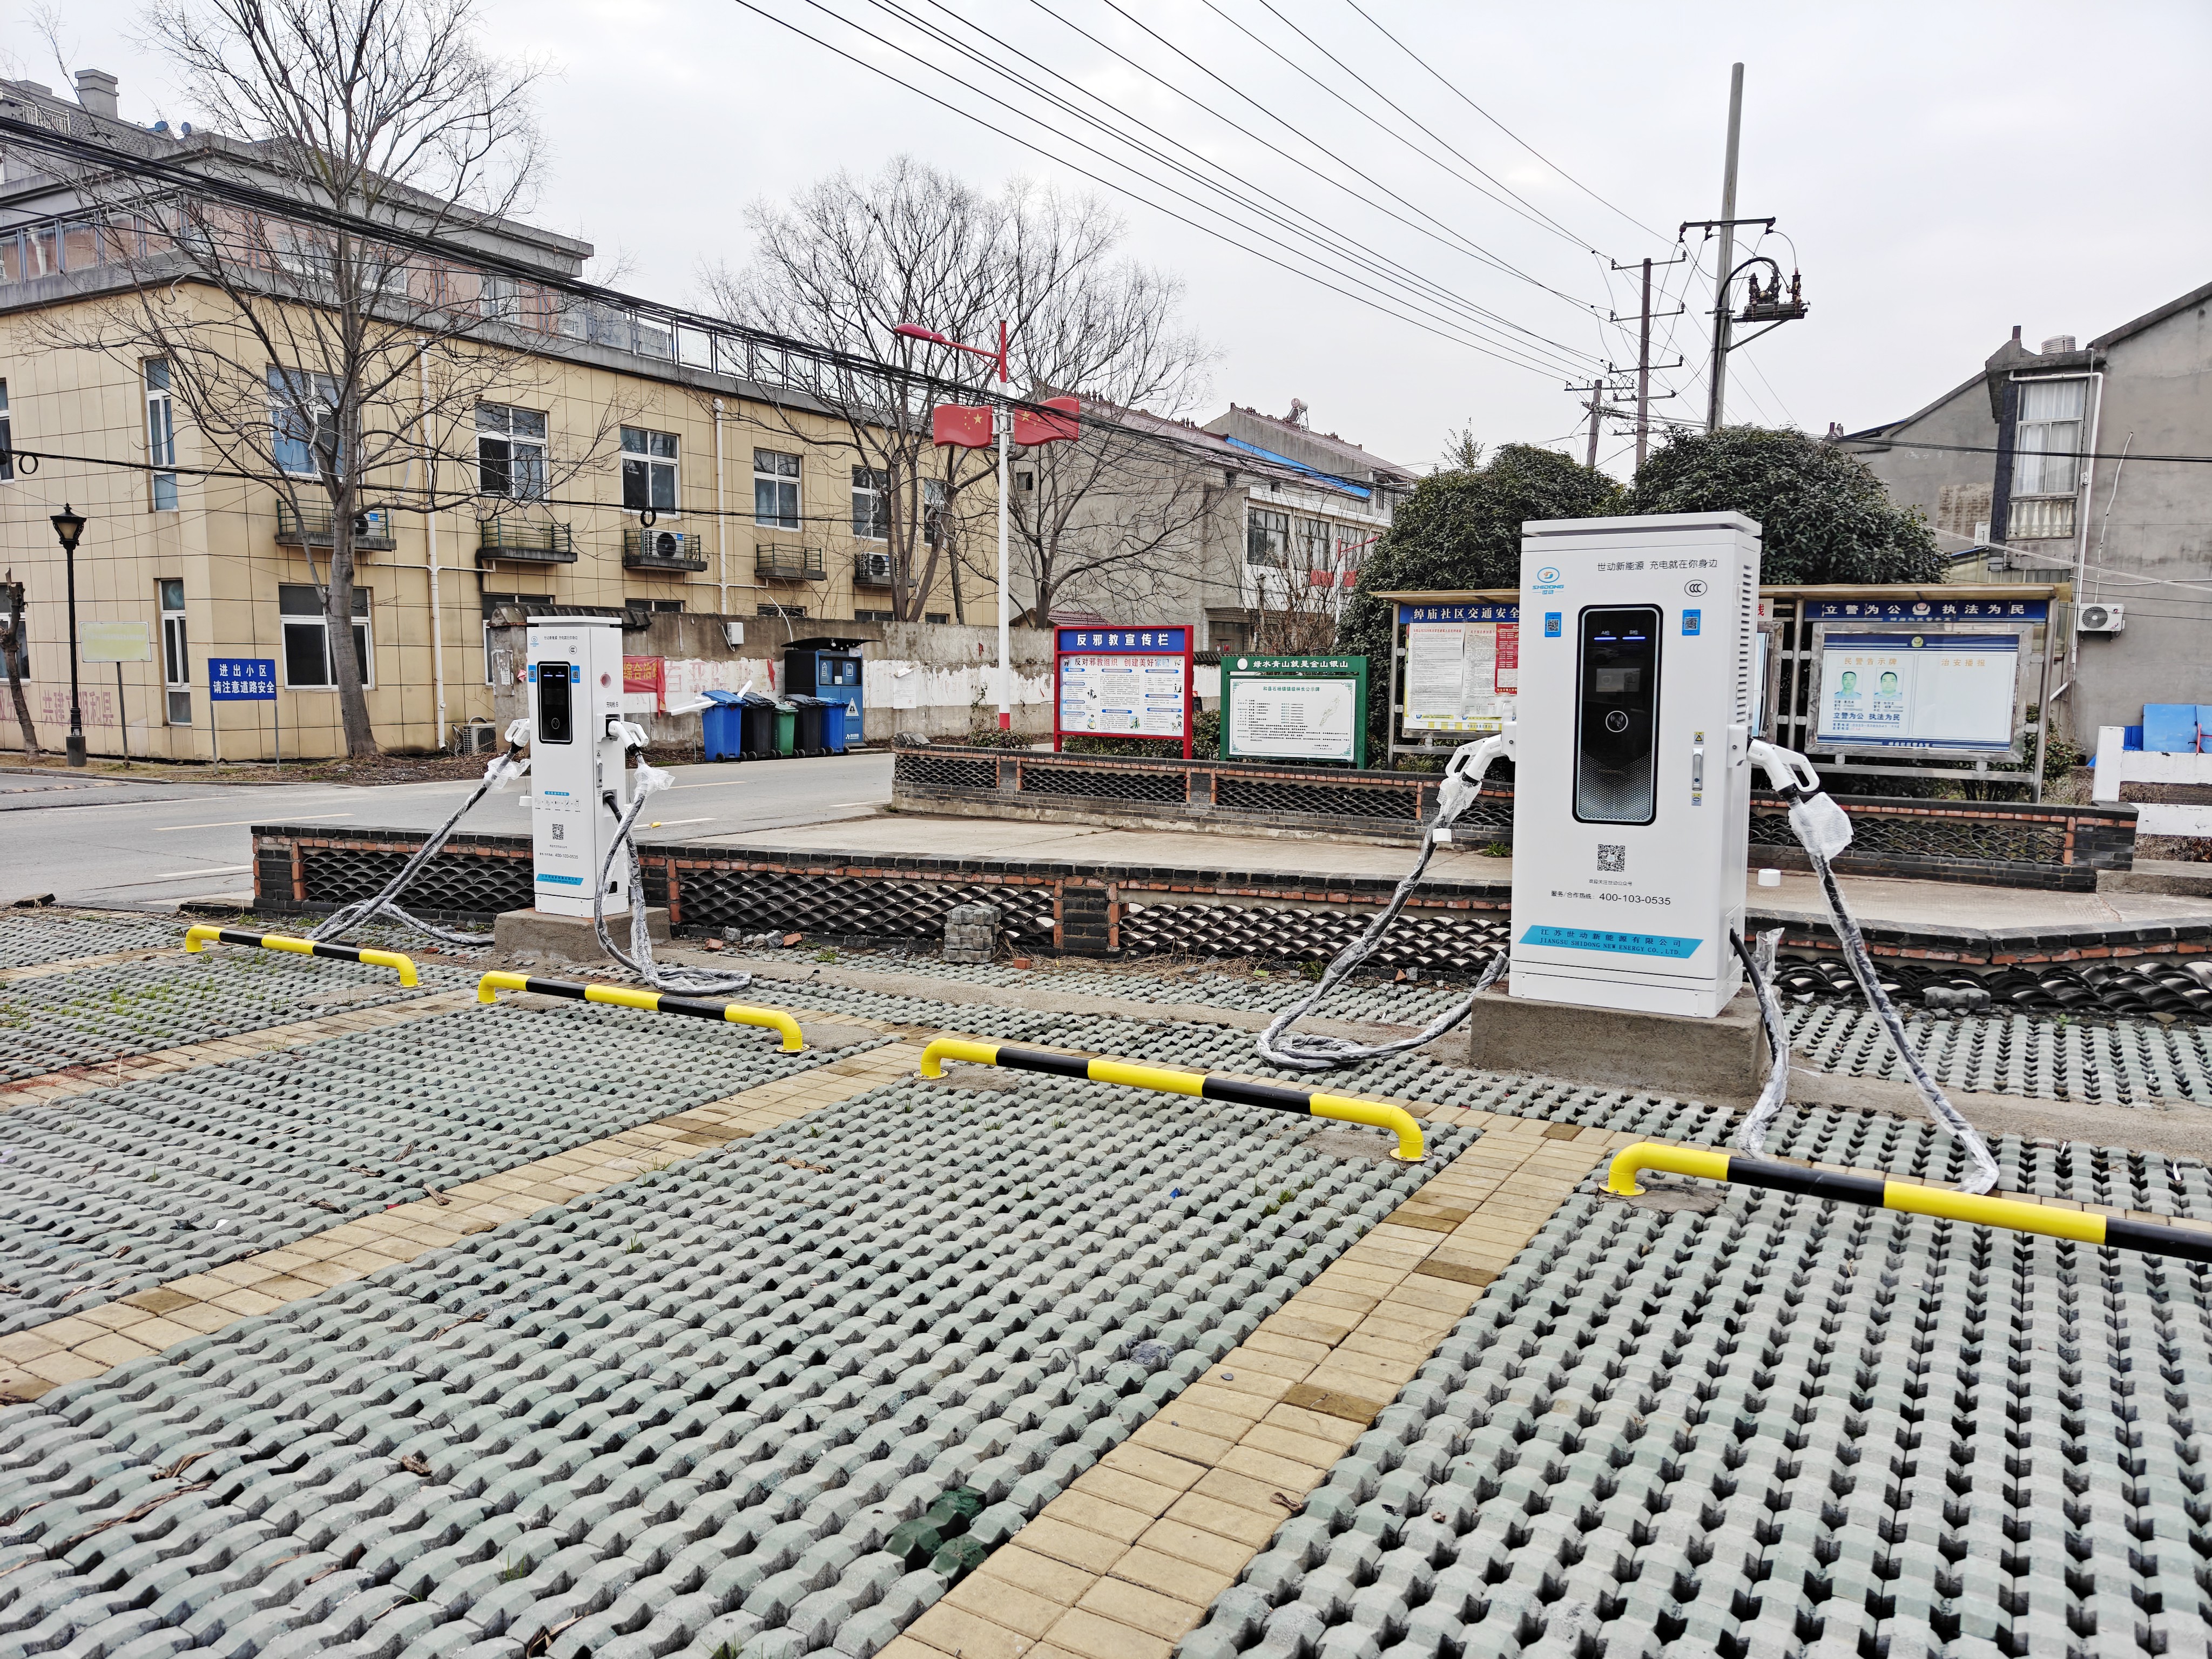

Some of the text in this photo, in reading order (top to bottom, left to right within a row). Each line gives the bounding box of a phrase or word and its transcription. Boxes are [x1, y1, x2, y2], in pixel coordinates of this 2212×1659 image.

[1597, 558, 1718, 571] 世动新能源 充电就在你身边
[1413, 607, 1519, 620] 绰庙社区交通安全
[1824, 604, 2026, 615] 立警为公 执法为民
[1076, 633, 1169, 646] 反邪教宣传栏
[1074, 658, 1118, 667] 反对邪教组织
[1252, 660, 1348, 669] 绿水青山就是金山银山
[219, 664, 267, 677] 进出小区
[213, 680, 275, 693] 请注意道路安全
[1599, 893, 1671, 905] 400-103-0535
[1540, 928, 1681, 947] 江苏世动新能源有限公司
[1570, 940, 1600, 948] SHIDONG
[1619, 944, 1644, 952] ENERGY
